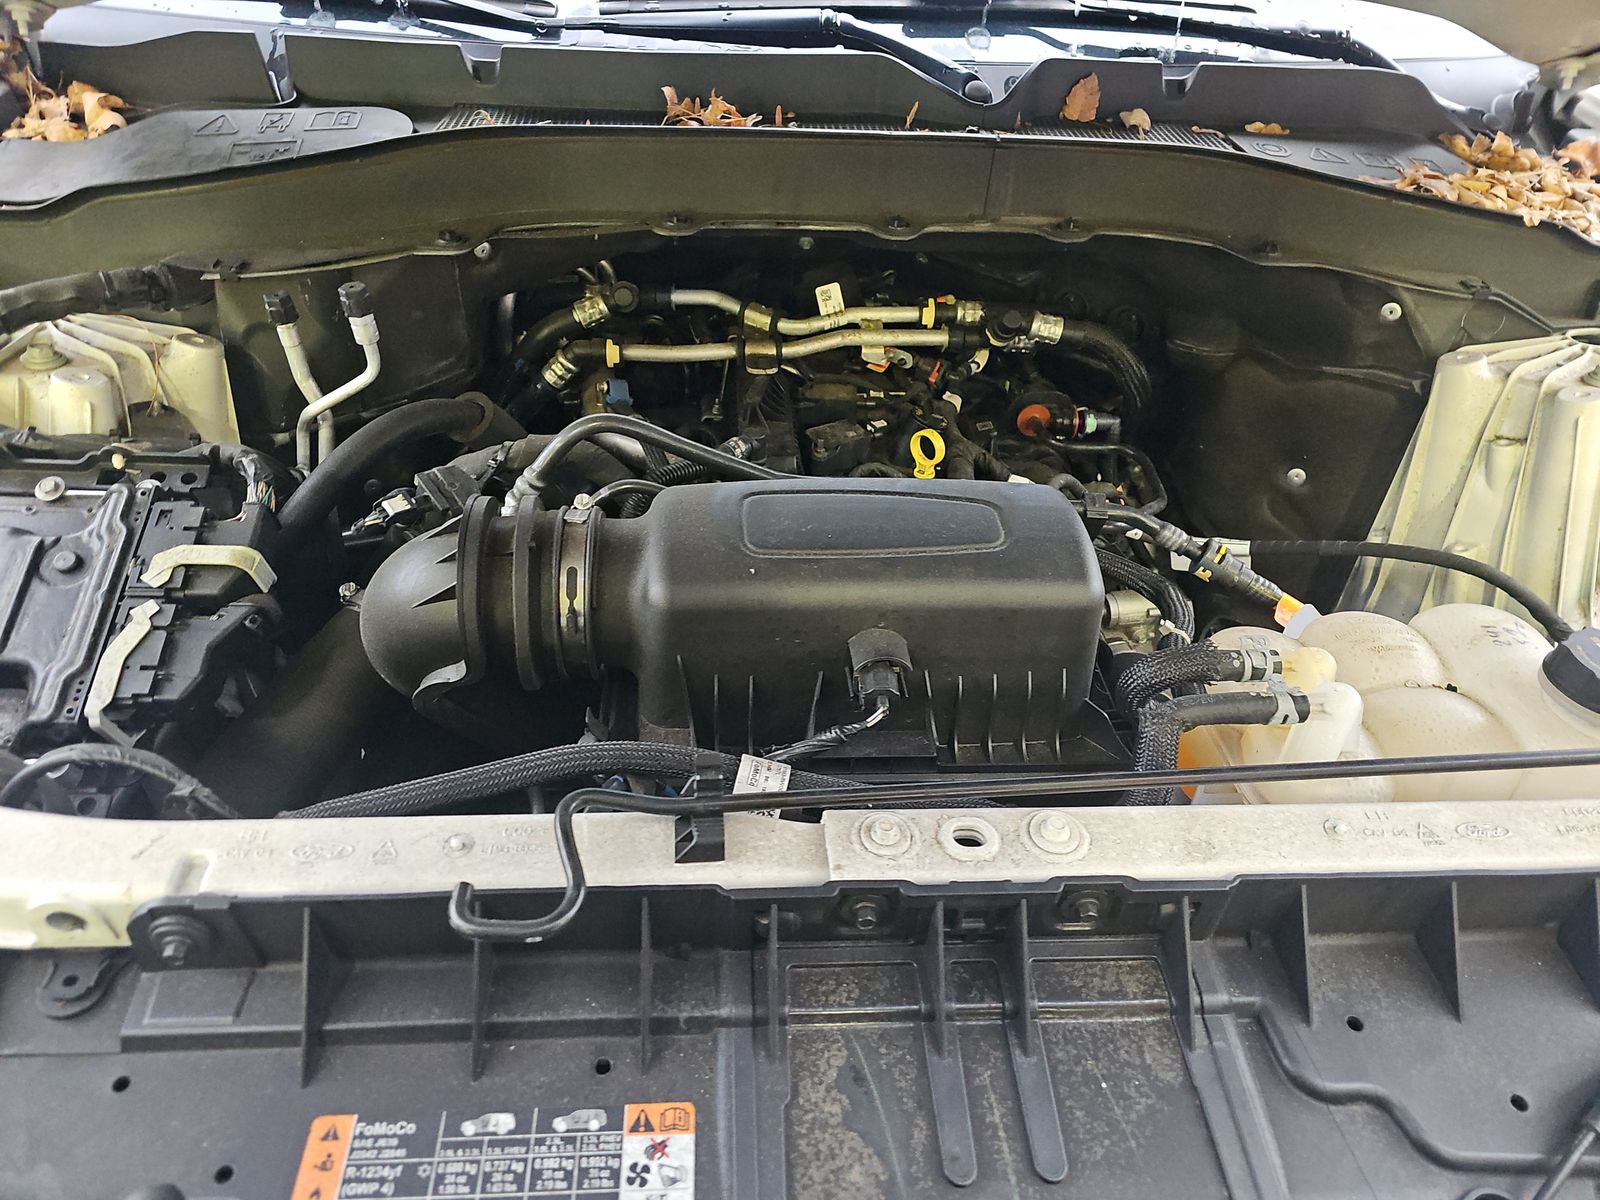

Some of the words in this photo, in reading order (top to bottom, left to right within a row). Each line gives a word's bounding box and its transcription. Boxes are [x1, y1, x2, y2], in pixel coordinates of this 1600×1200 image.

[354, 1121, 417, 1136] FoMoCo
[345, 1165, 403, 1180] R-1234yf
[341, 1182, 380, 1198] (GWP
[380, 1182, 395, 1196] 4)
